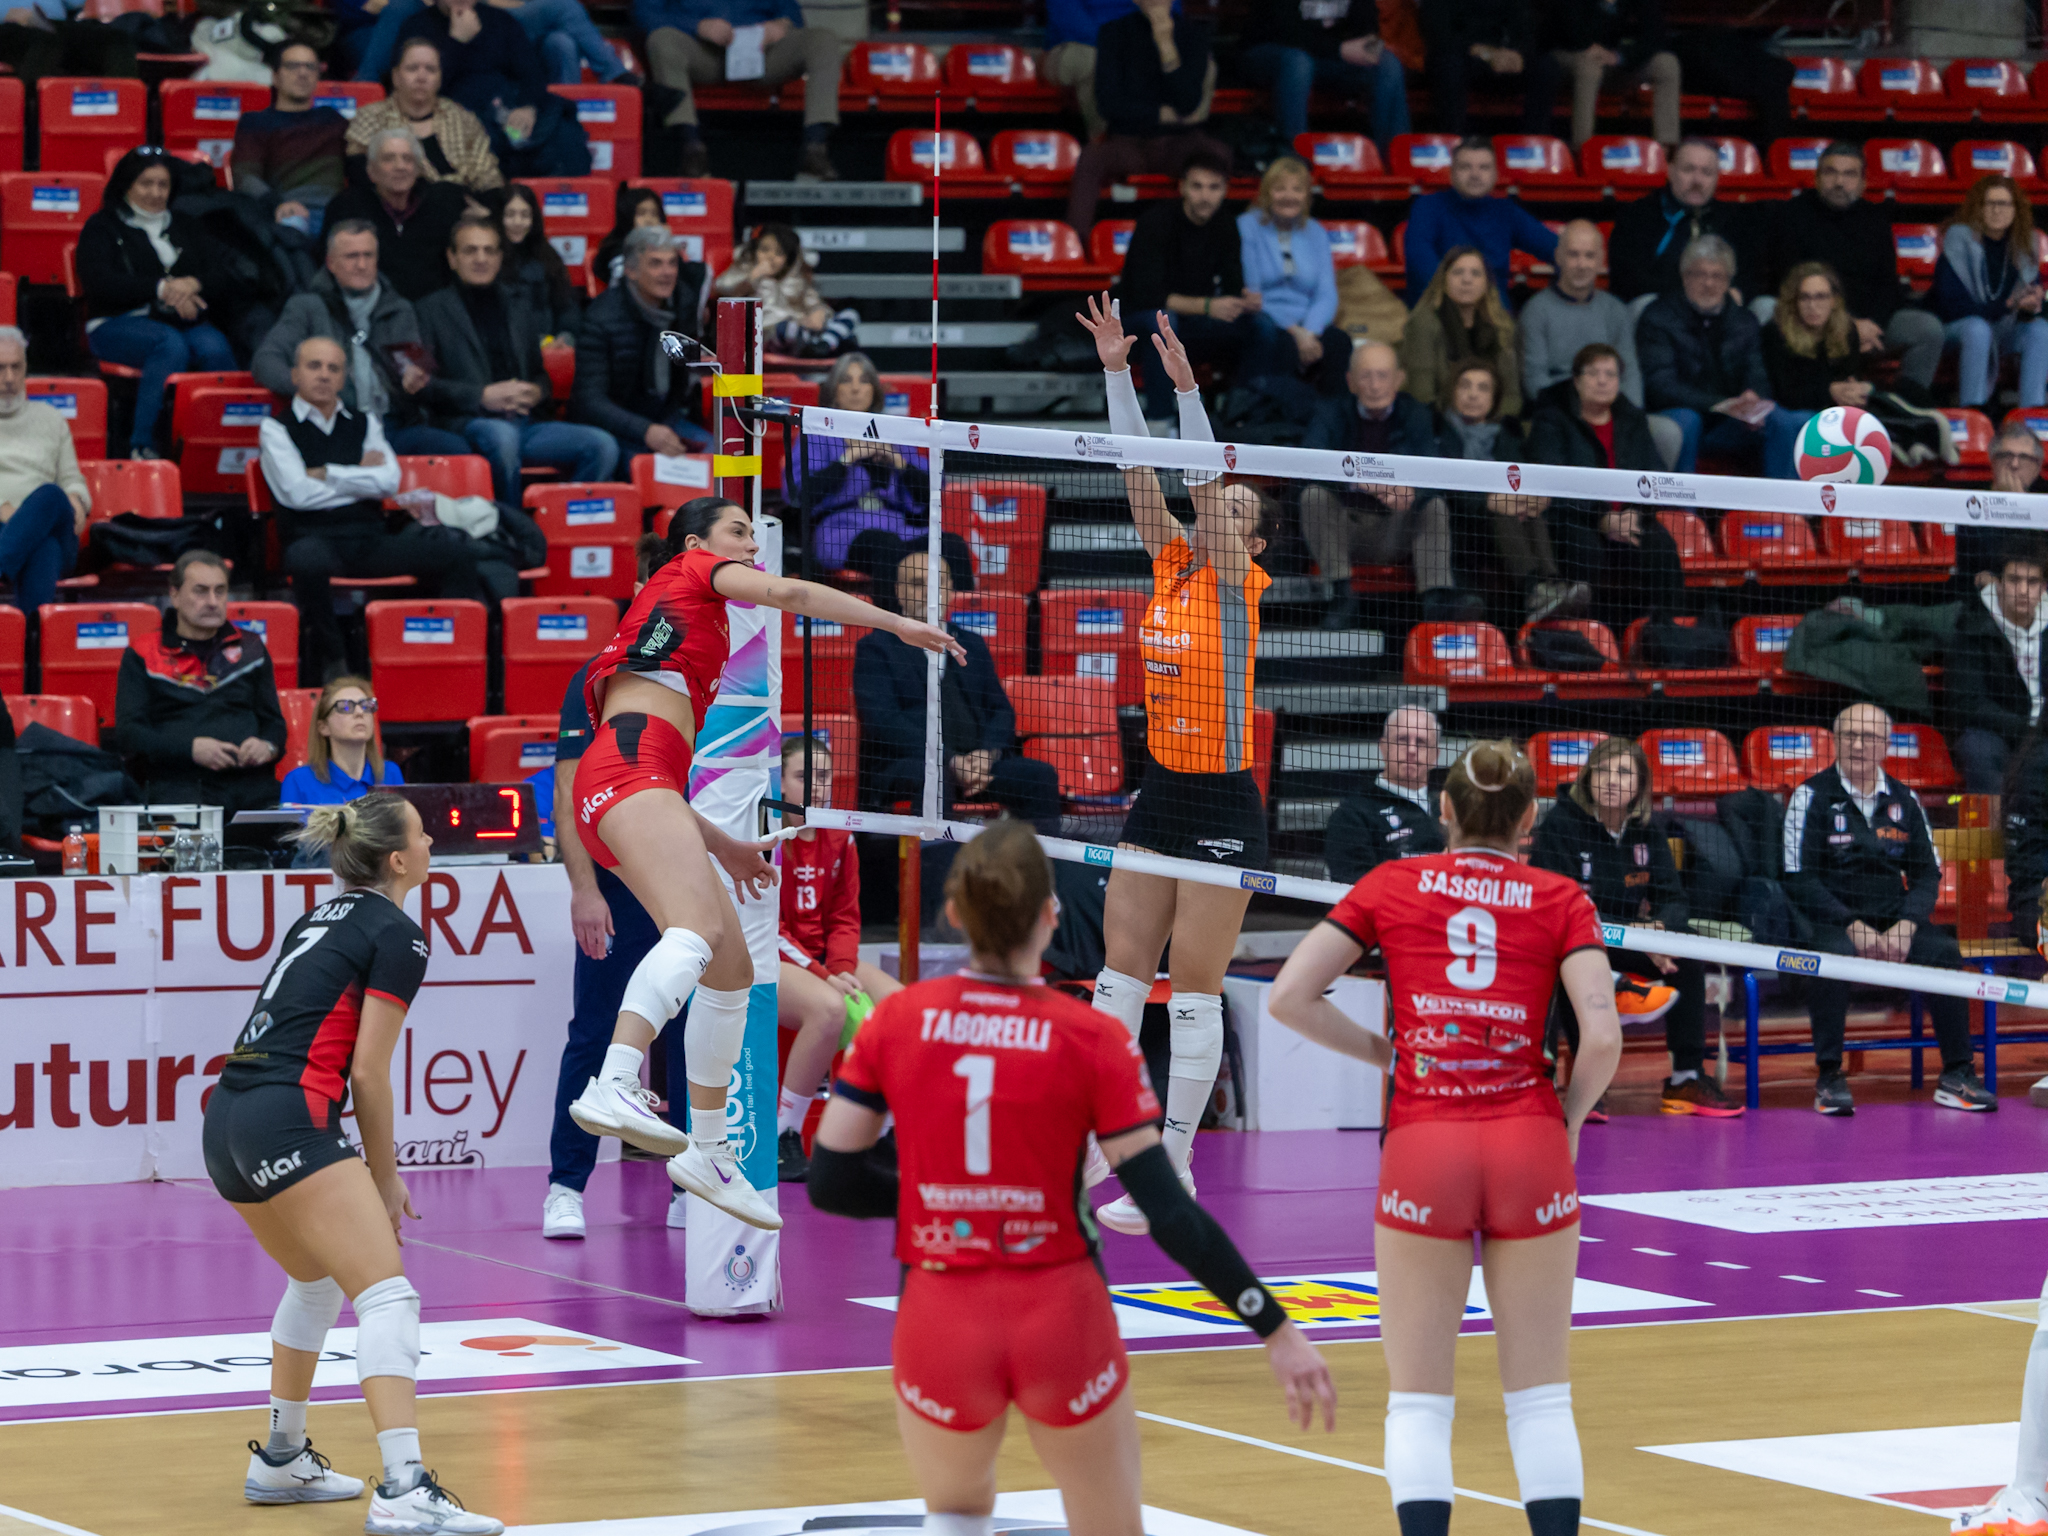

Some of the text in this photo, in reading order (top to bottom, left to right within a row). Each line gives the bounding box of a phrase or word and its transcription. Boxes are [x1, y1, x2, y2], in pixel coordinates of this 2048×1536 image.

[1093, 448, 1123, 458] International
[1361, 469, 1396, 479] International
[1659, 490, 1697, 500] International
[1990, 510, 2031, 521] International
[580, 786, 614, 825] viar
[796, 885, 817, 910] 13
[1242, 874, 1275, 891] FINECO
[1417, 869, 1533, 909] SASSOLINI
[0, 871, 536, 968] RE FUTRA
[262, 926, 330, 1000] 7
[1445, 905, 1497, 991] 9
[1779, 954, 1818, 973] FINECO
[920, 1008, 1052, 1052] TABORELLI
[743, 1047, 754, 1071] good
[744, 1073, 753, 1090] feel
[953, 1053, 995, 1176] 1
[251, 1150, 301, 1188] viar
[1381, 1189, 1432, 1225] viar
[1068, 1359, 1119, 1416] viar
